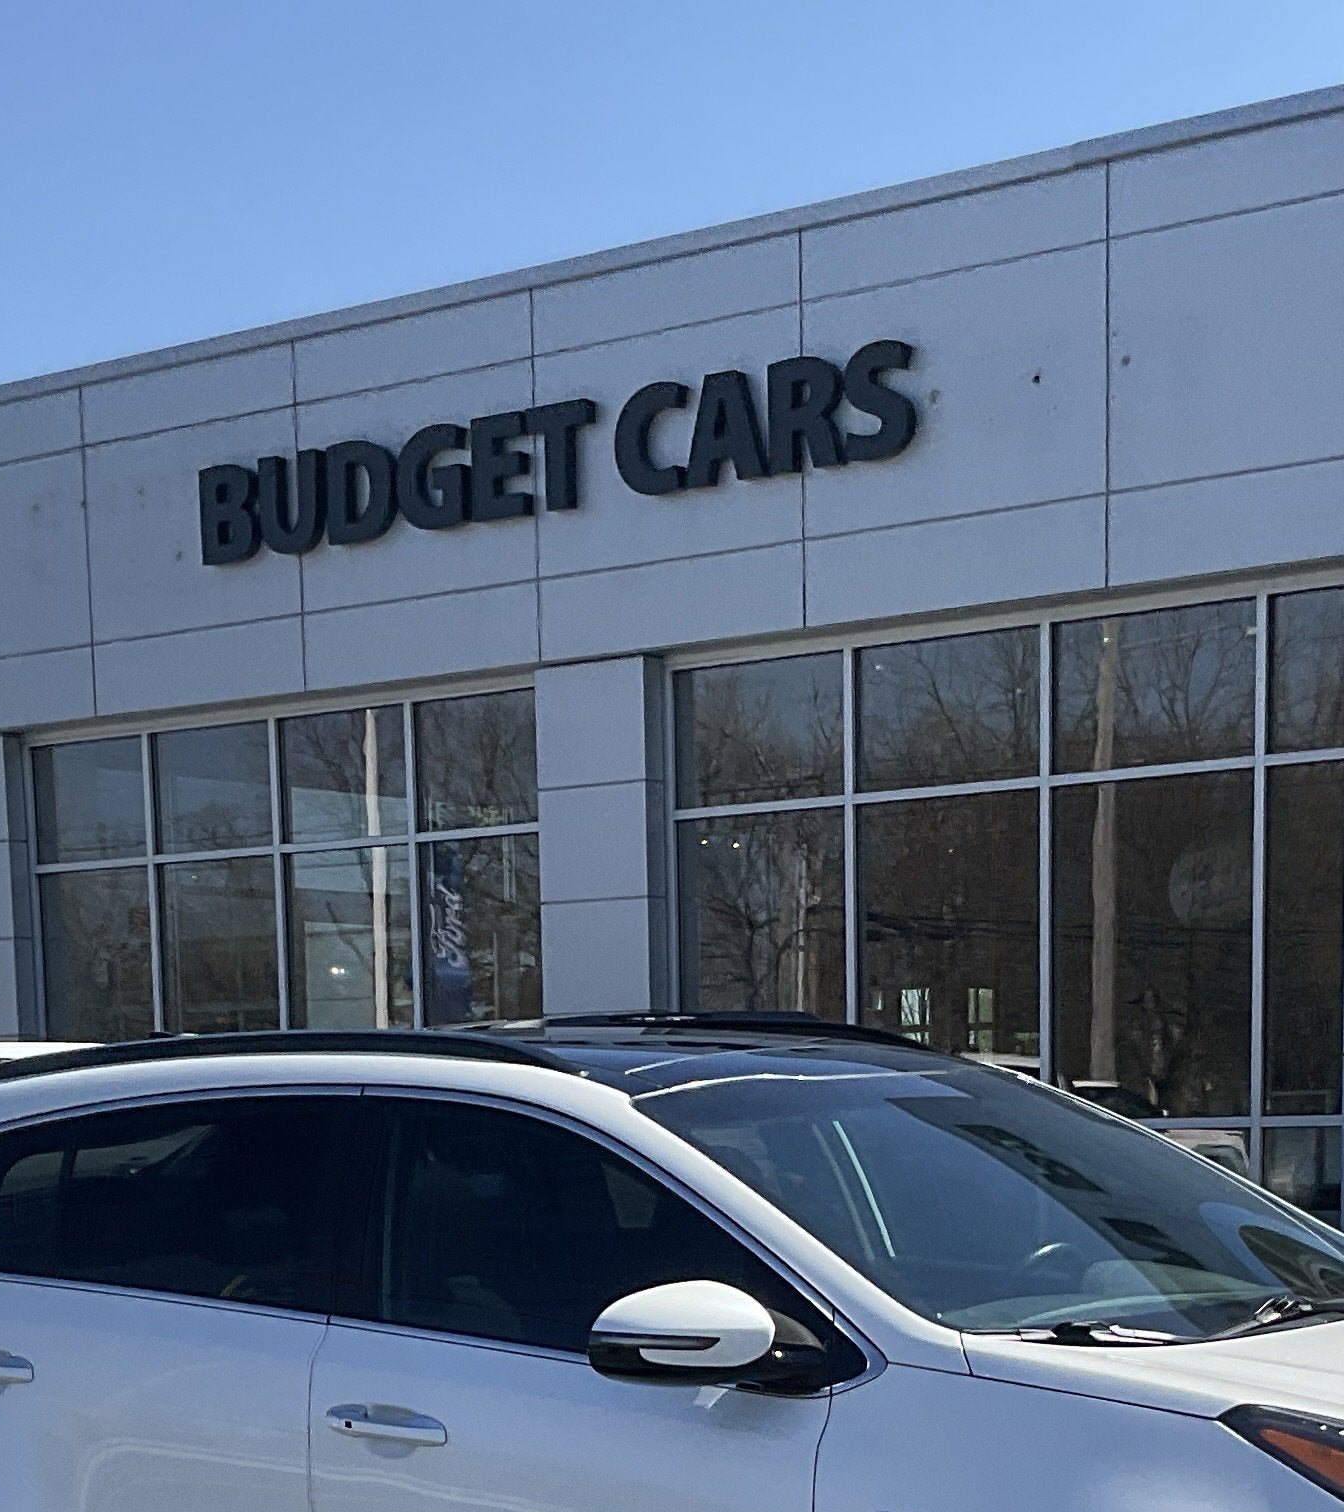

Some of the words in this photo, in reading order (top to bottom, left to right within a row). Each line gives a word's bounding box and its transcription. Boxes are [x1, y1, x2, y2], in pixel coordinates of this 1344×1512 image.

[199, 398, 598, 566] BUDGET
[615, 339, 918, 496] CARS
[429, 882, 468, 967] Ford
